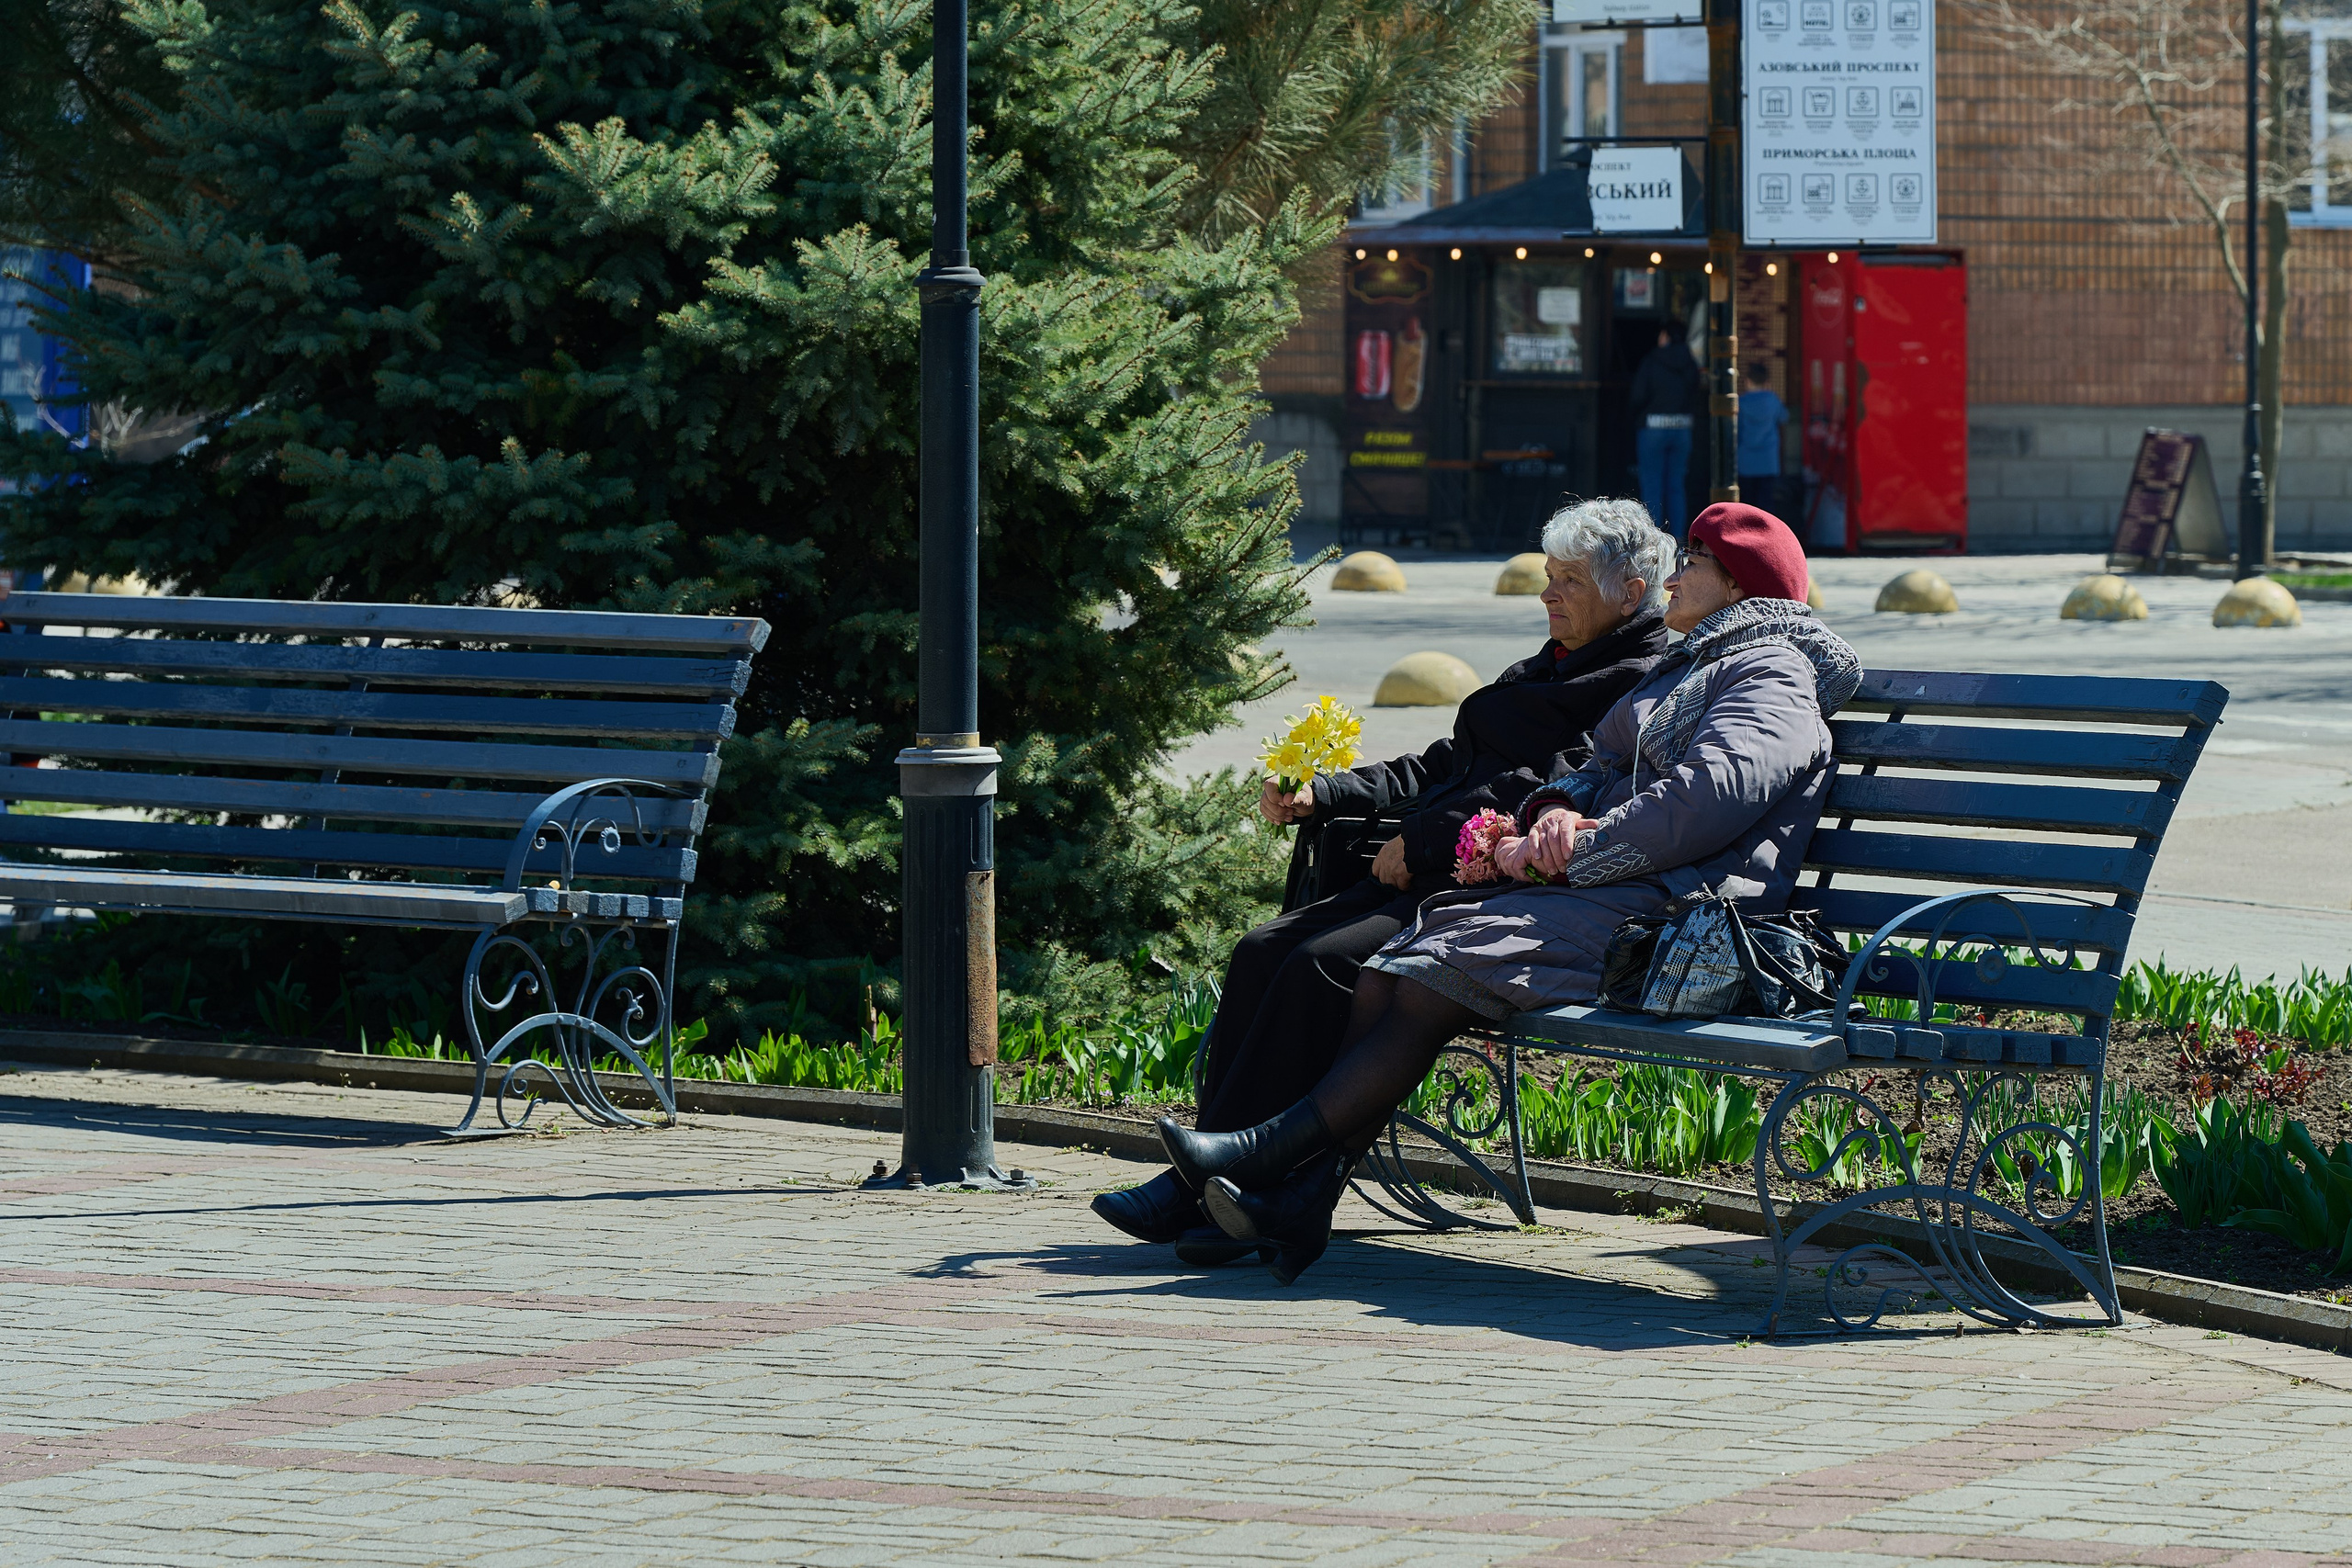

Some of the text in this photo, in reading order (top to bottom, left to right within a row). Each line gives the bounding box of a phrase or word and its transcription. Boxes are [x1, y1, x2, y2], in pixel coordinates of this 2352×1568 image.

[1758, 61, 1920, 73] АЗОВСЬКИЙ ПРОСПЕКТ
[1763, 148, 1917, 160] ПРИМОРСЬКА ПЛОЩА
